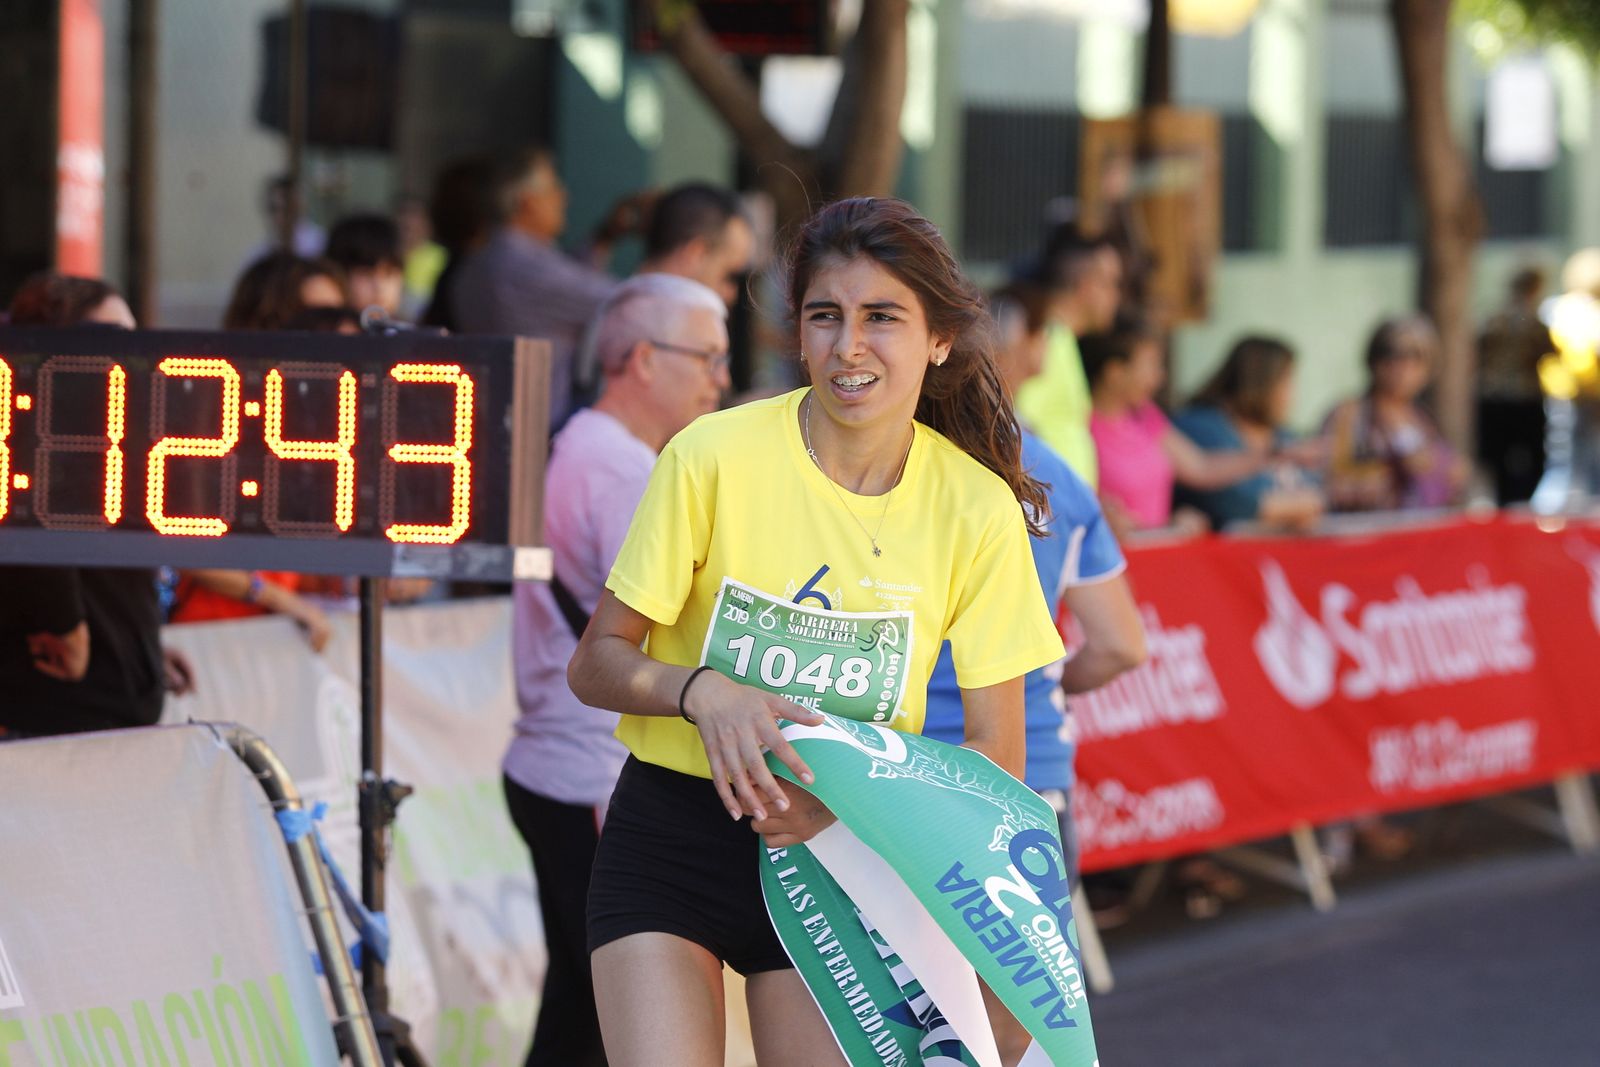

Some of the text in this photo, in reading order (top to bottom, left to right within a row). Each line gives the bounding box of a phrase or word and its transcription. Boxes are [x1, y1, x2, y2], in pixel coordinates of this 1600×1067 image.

[722, 604, 750, 624] 2019
[729, 588, 755, 605] ALMERIA
[786, 623, 857, 644] SOLIDARIA
[789, 611, 858, 633] CARRERA
[727, 633, 873, 698] 1048
[777, 864, 817, 913] LAS
[984, 863, 1043, 919] 2
[935, 861, 1079, 1030] ALMERIA
[1021, 924, 1077, 1009] Domingo
